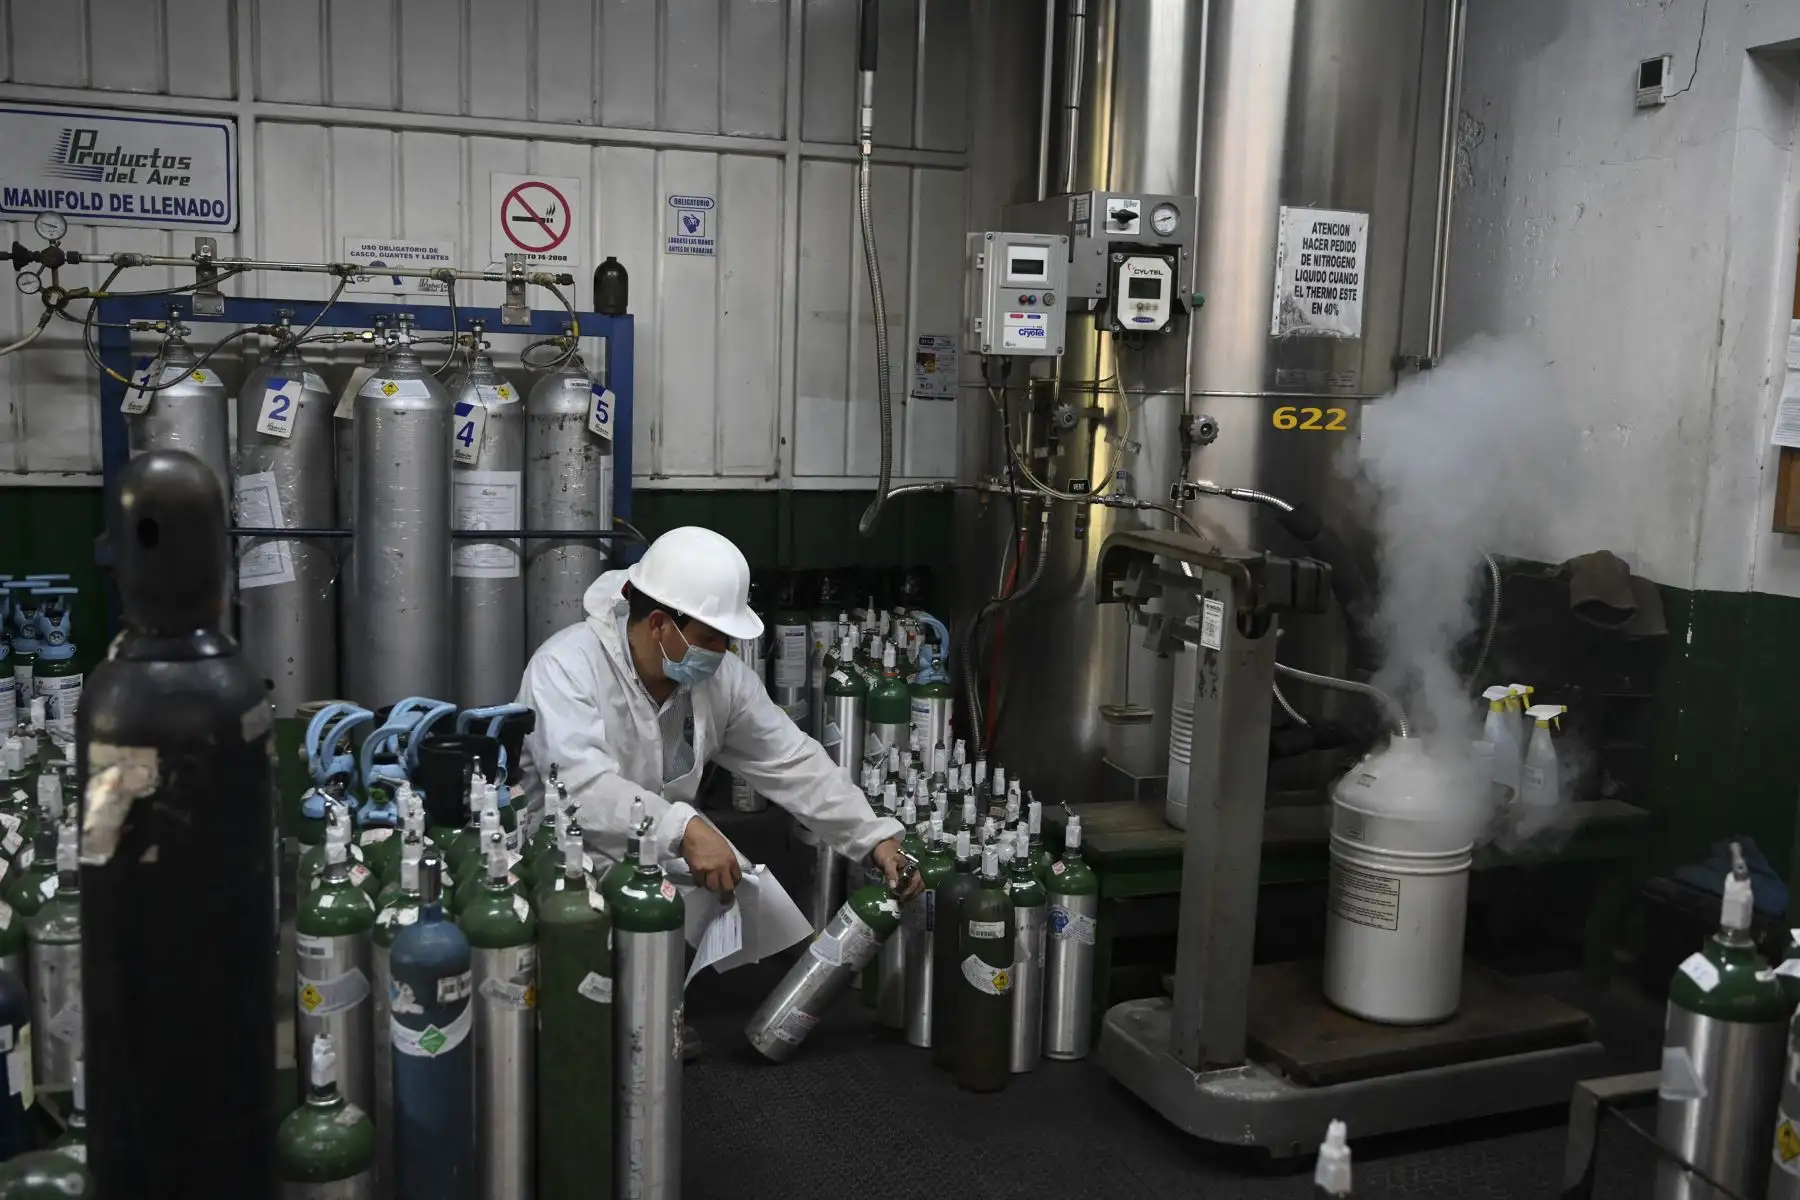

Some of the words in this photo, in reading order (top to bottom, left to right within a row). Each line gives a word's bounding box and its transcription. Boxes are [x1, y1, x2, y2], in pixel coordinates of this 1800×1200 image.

[68, 129, 192, 170] Productos
[4, 187, 103, 212] MANIFOLD
[110, 193, 134, 213] DE
[140, 195, 225, 218] LLENADO
[673, 198, 710, 207] OBLIGATORIO
[1311, 222, 1351, 237] ATENCION
[378, 245, 427, 253] OBLIGATORIO
[668, 245, 683, 253] ANTES
[1302, 238, 1329, 251] HACER
[1330, 239, 1357, 253] PEDIDO
[350, 251, 378, 259] CASCO,
[379, 252, 414, 260] GUANTES
[1300, 253, 1311, 266] DE
[1313, 254, 1356, 269] NITROGENO
[1294, 269, 1327, 283] LIQUIDO
[1328, 271, 1358, 285] CUANDO
[1294, 285, 1304, 298] EL
[1306, 286, 1338, 300] THERMO
[1339, 288, 1357, 301] ESTE
[1311, 302, 1323, 315] EN
[1324, 302, 1339, 316] 40%
[138, 374, 151, 399] 1
[268, 394, 290, 421] 2
[595, 399, 609, 424] 5
[1272, 406, 1346, 431] 622
[456, 421, 475, 448] 4
